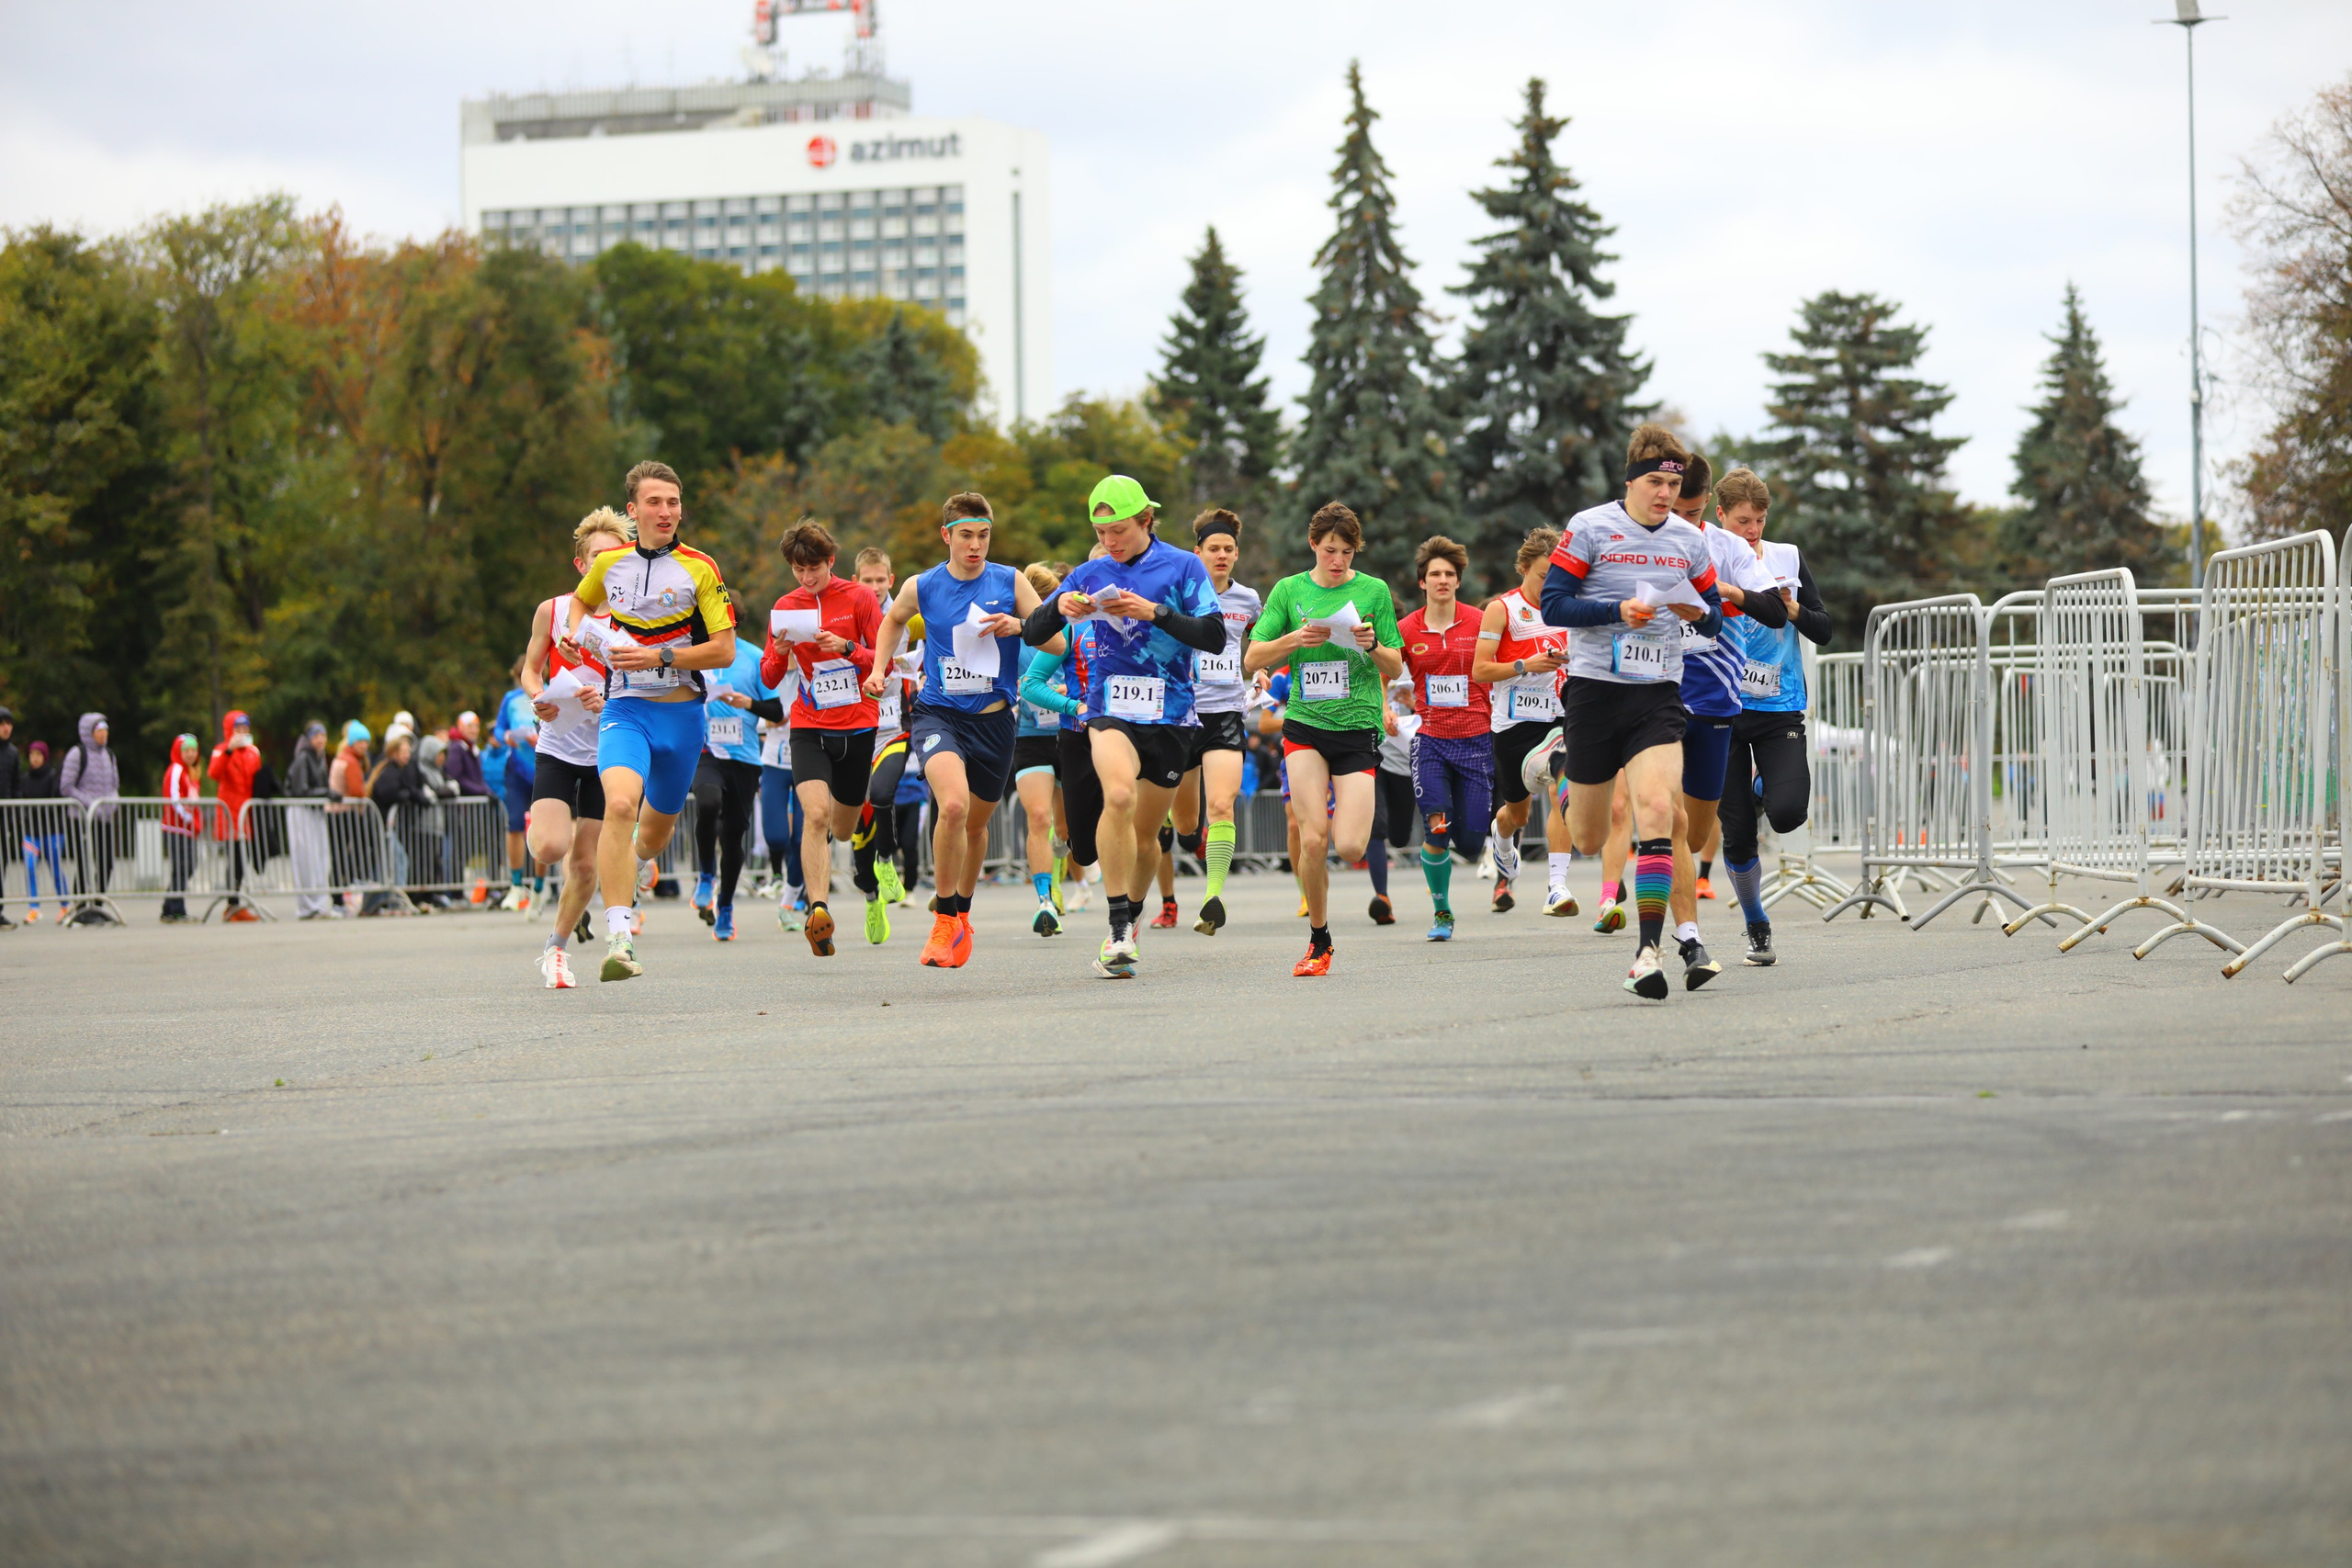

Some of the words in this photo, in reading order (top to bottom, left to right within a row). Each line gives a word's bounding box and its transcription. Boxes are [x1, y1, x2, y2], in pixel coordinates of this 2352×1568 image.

[850, 131, 962, 163] azimut
[1600, 554, 1647, 565] NORD
[1655, 555, 1690, 569] WEST
[1223, 612, 1250, 622] WEST
[1623, 645, 1661, 663] 210.1
[1201, 659, 1233, 671] 216.1
[1305, 671, 1340, 684] 207.1
[816, 678, 849, 694] 232.1
[1112, 684, 1153, 701] 219.1
[1430, 682, 1461, 694] 206.1
[1516, 695, 1549, 709] 209.1
[711, 725, 736, 734] 231.1
